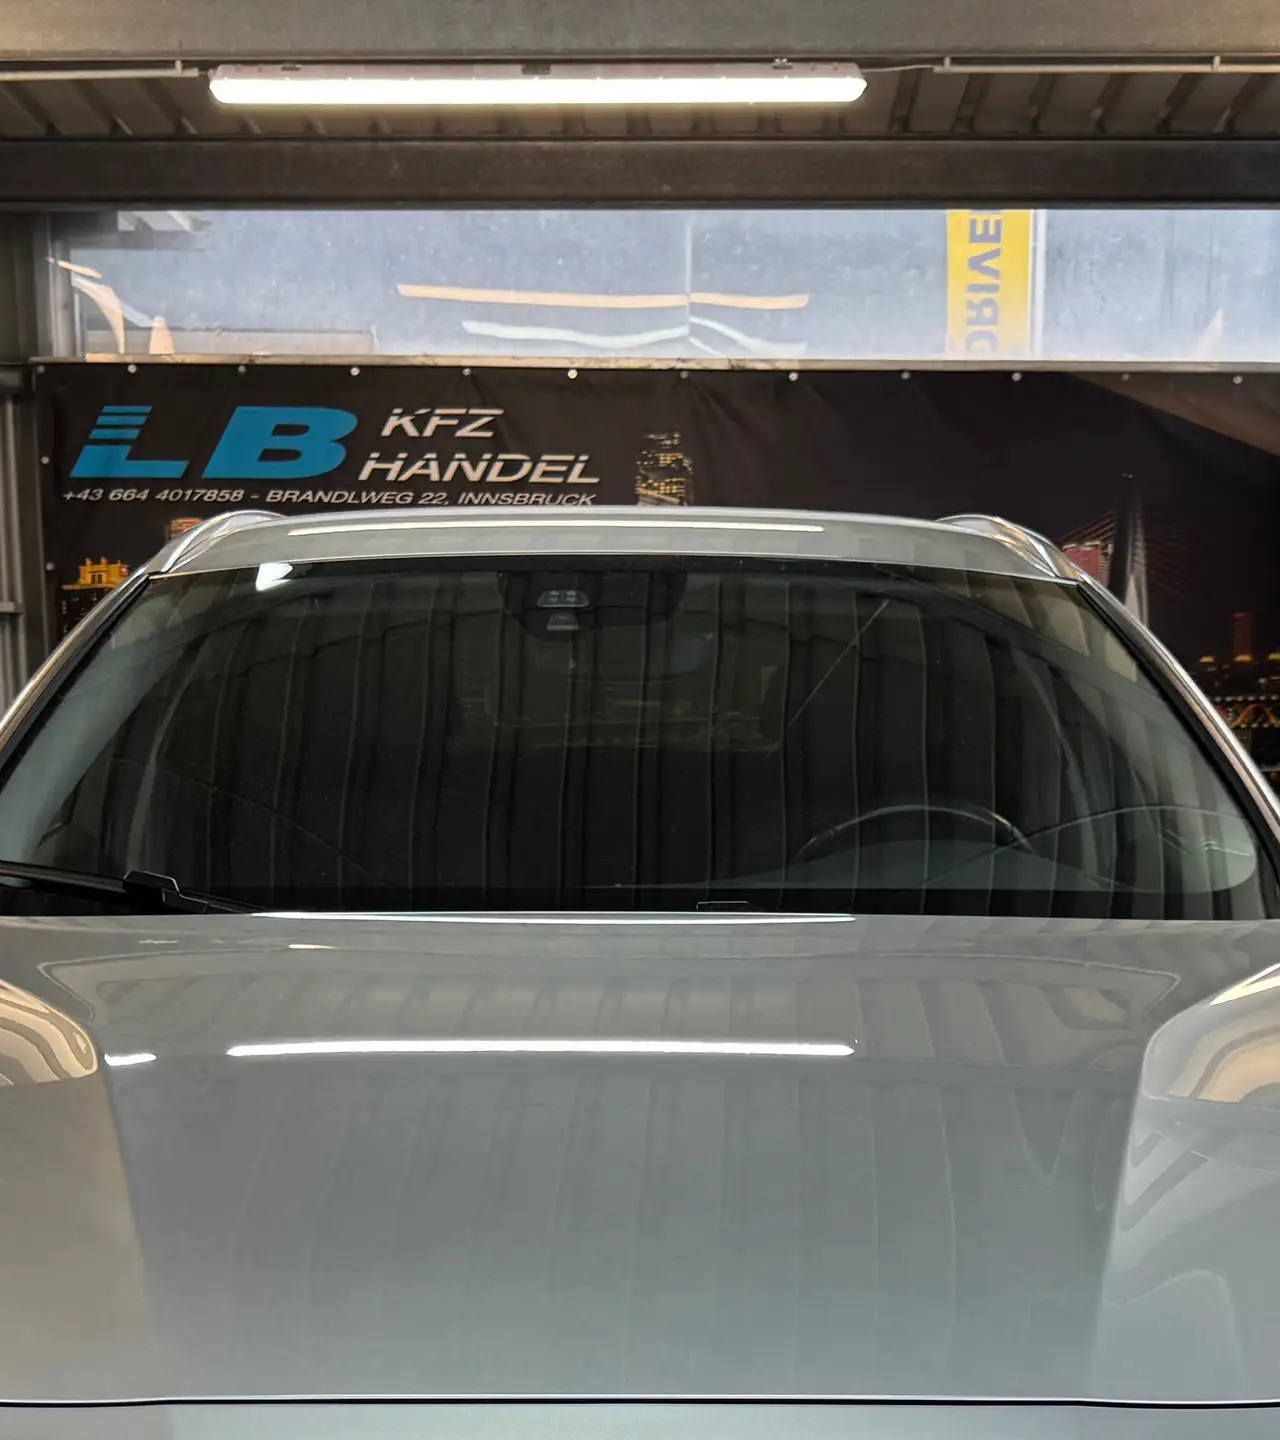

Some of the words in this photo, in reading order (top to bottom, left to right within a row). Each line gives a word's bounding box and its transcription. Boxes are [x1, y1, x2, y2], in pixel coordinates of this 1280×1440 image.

[380, 407, 505, 438] KFZ
[70, 406, 359, 479] LB
[358, 453, 601, 484] HANDEL
[62, 488, 103, 501] +43
[108, 488, 150, 501] 664
[155, 489, 245, 502] 4017858
[265, 490, 415, 505] BRANDLWEG
[458, 492, 599, 507] INNSBRUCK
